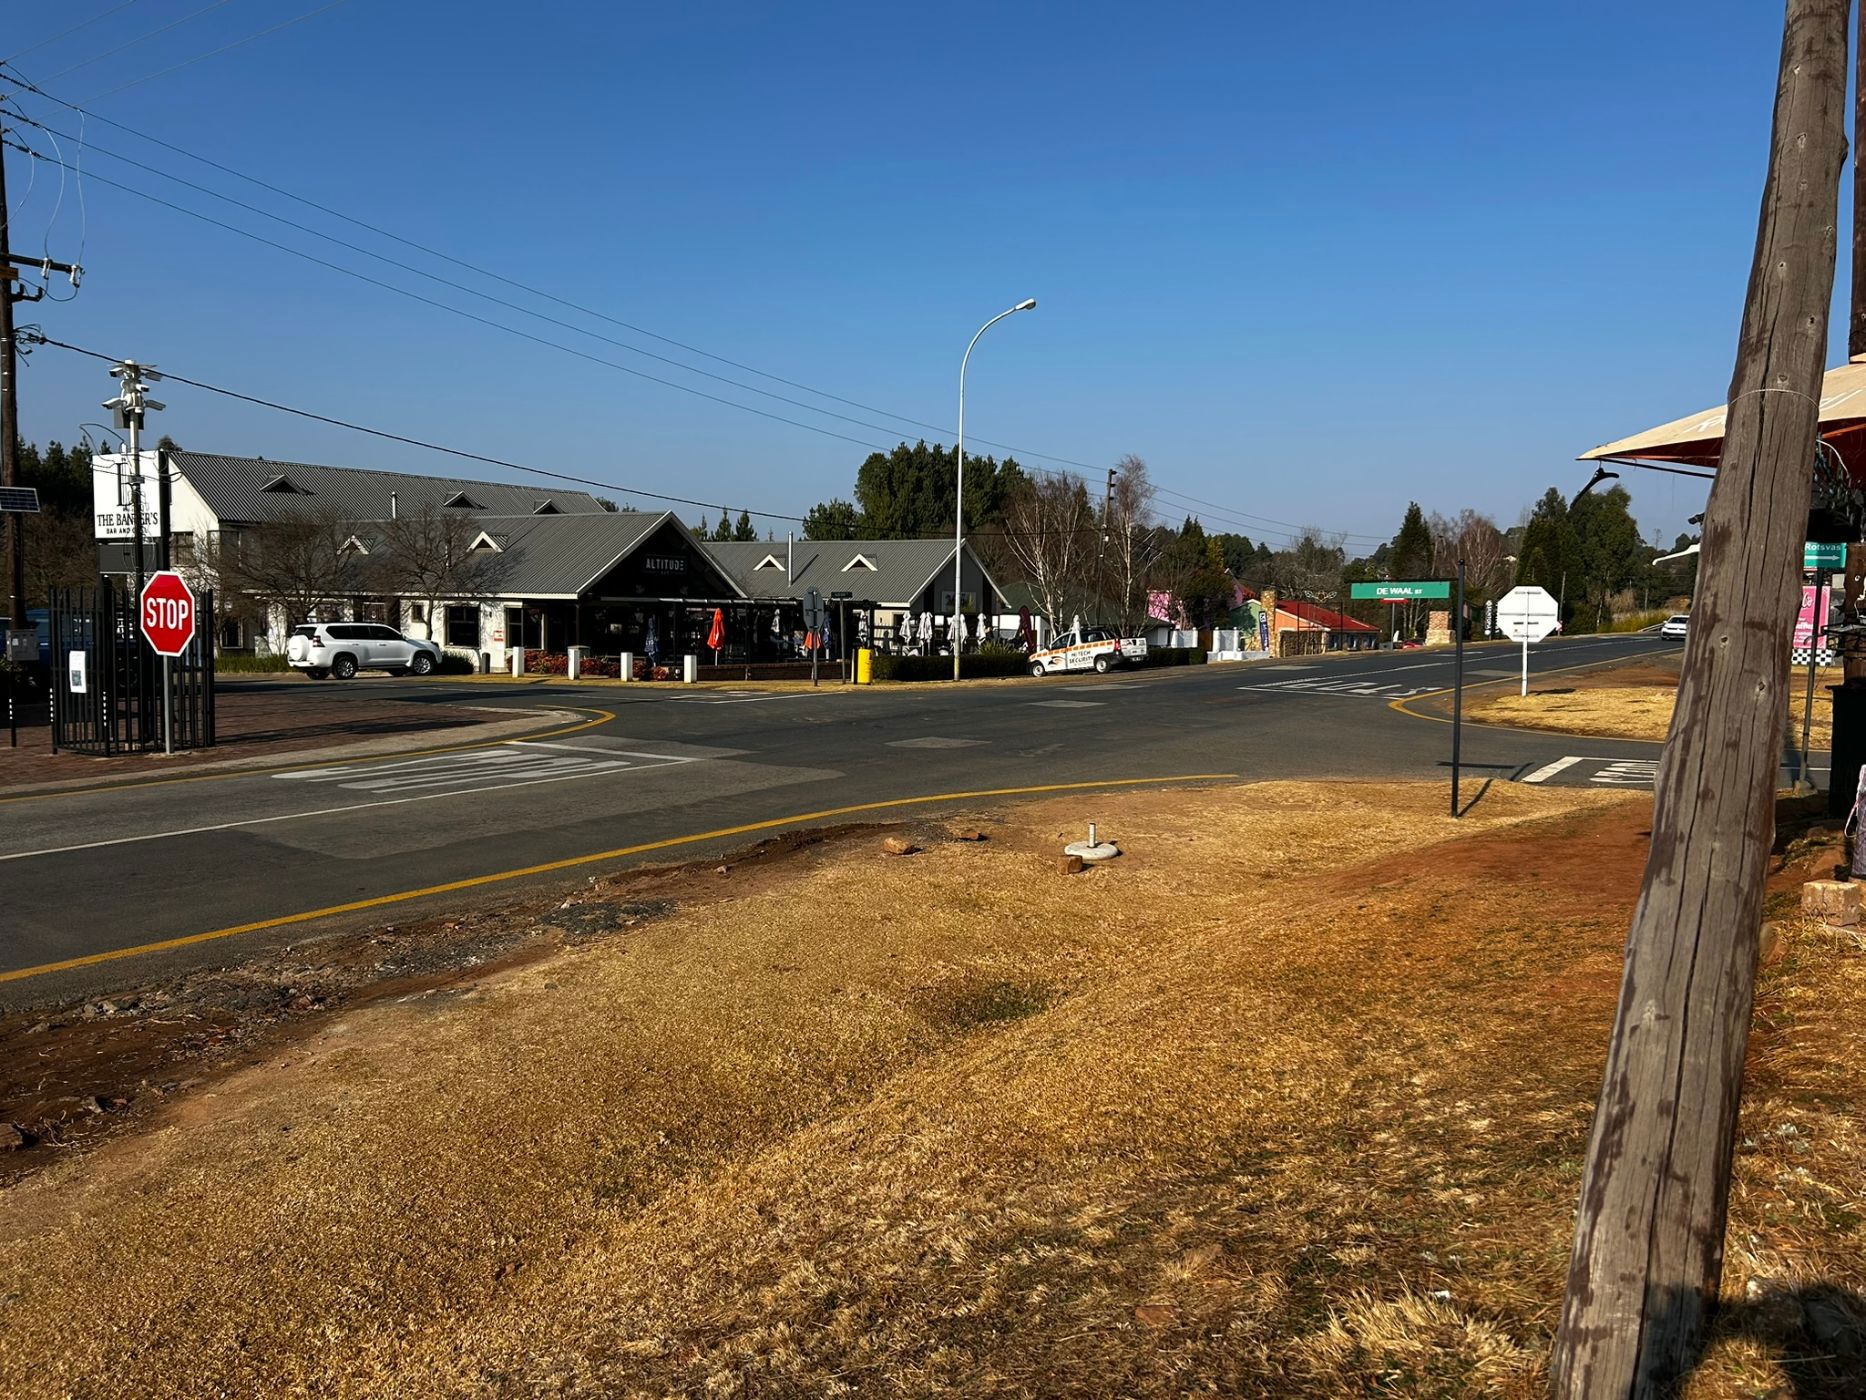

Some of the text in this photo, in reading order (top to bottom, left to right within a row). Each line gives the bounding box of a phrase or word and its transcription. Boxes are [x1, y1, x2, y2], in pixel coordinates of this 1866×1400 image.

[97, 512, 158, 526] THE BANER'S
[106, 527, 117, 535] BAR
[646, 558, 684, 570] ALTITUDE
[1376, 587, 1389, 595] DE
[1389, 587, 1413, 595] WAAL
[146, 597, 189, 630] STOP
[270, 749, 632, 793] STOP
